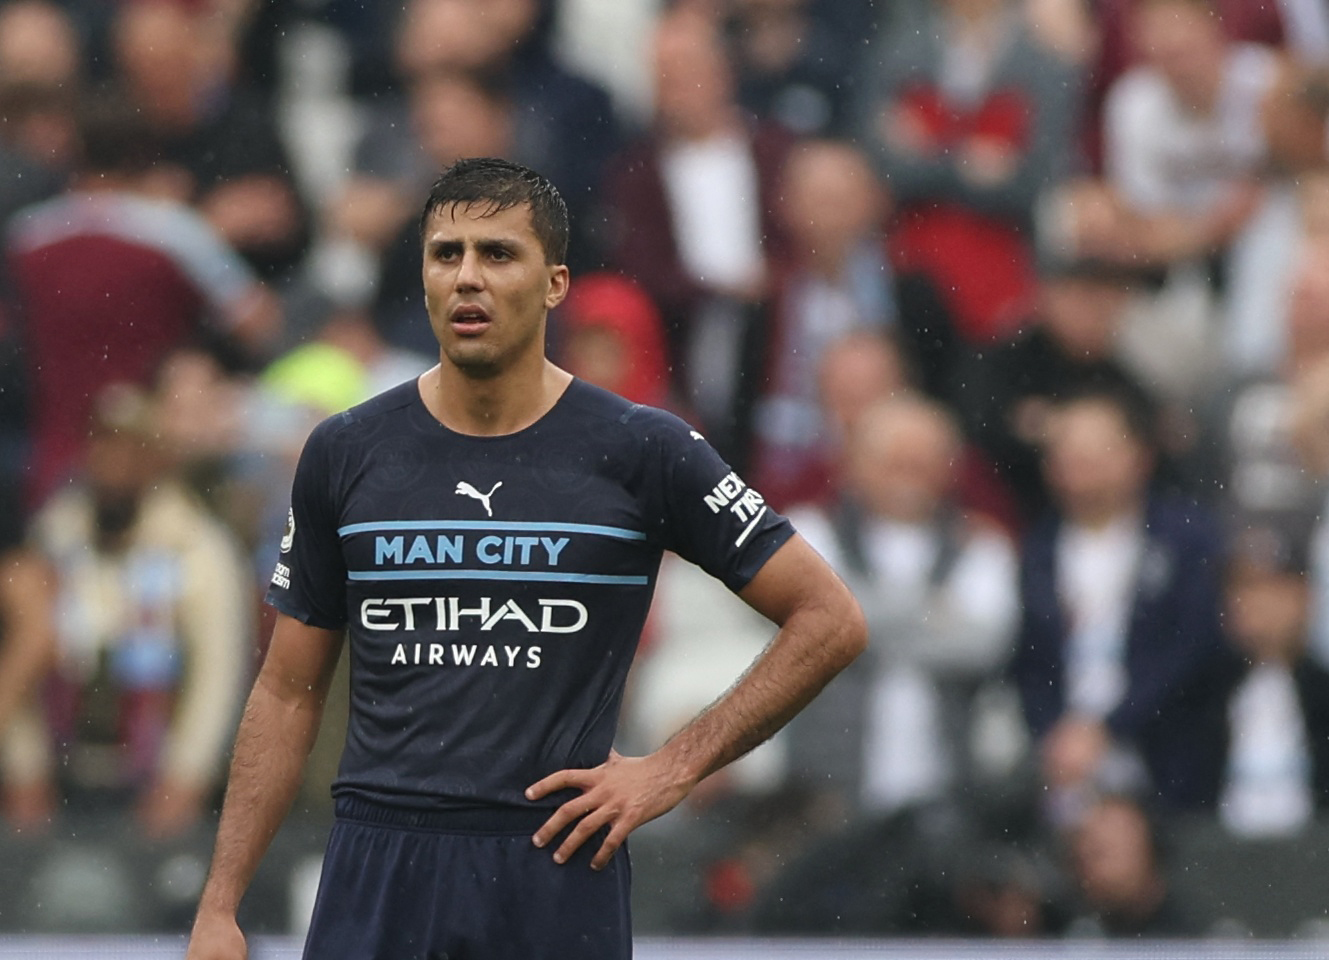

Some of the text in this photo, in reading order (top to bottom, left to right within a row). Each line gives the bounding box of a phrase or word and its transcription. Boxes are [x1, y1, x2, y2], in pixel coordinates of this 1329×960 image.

[374, 534, 571, 566] MAN CITY
[360, 597, 589, 634] ETIHAD
[391, 642, 543, 669] AIRWAYS
